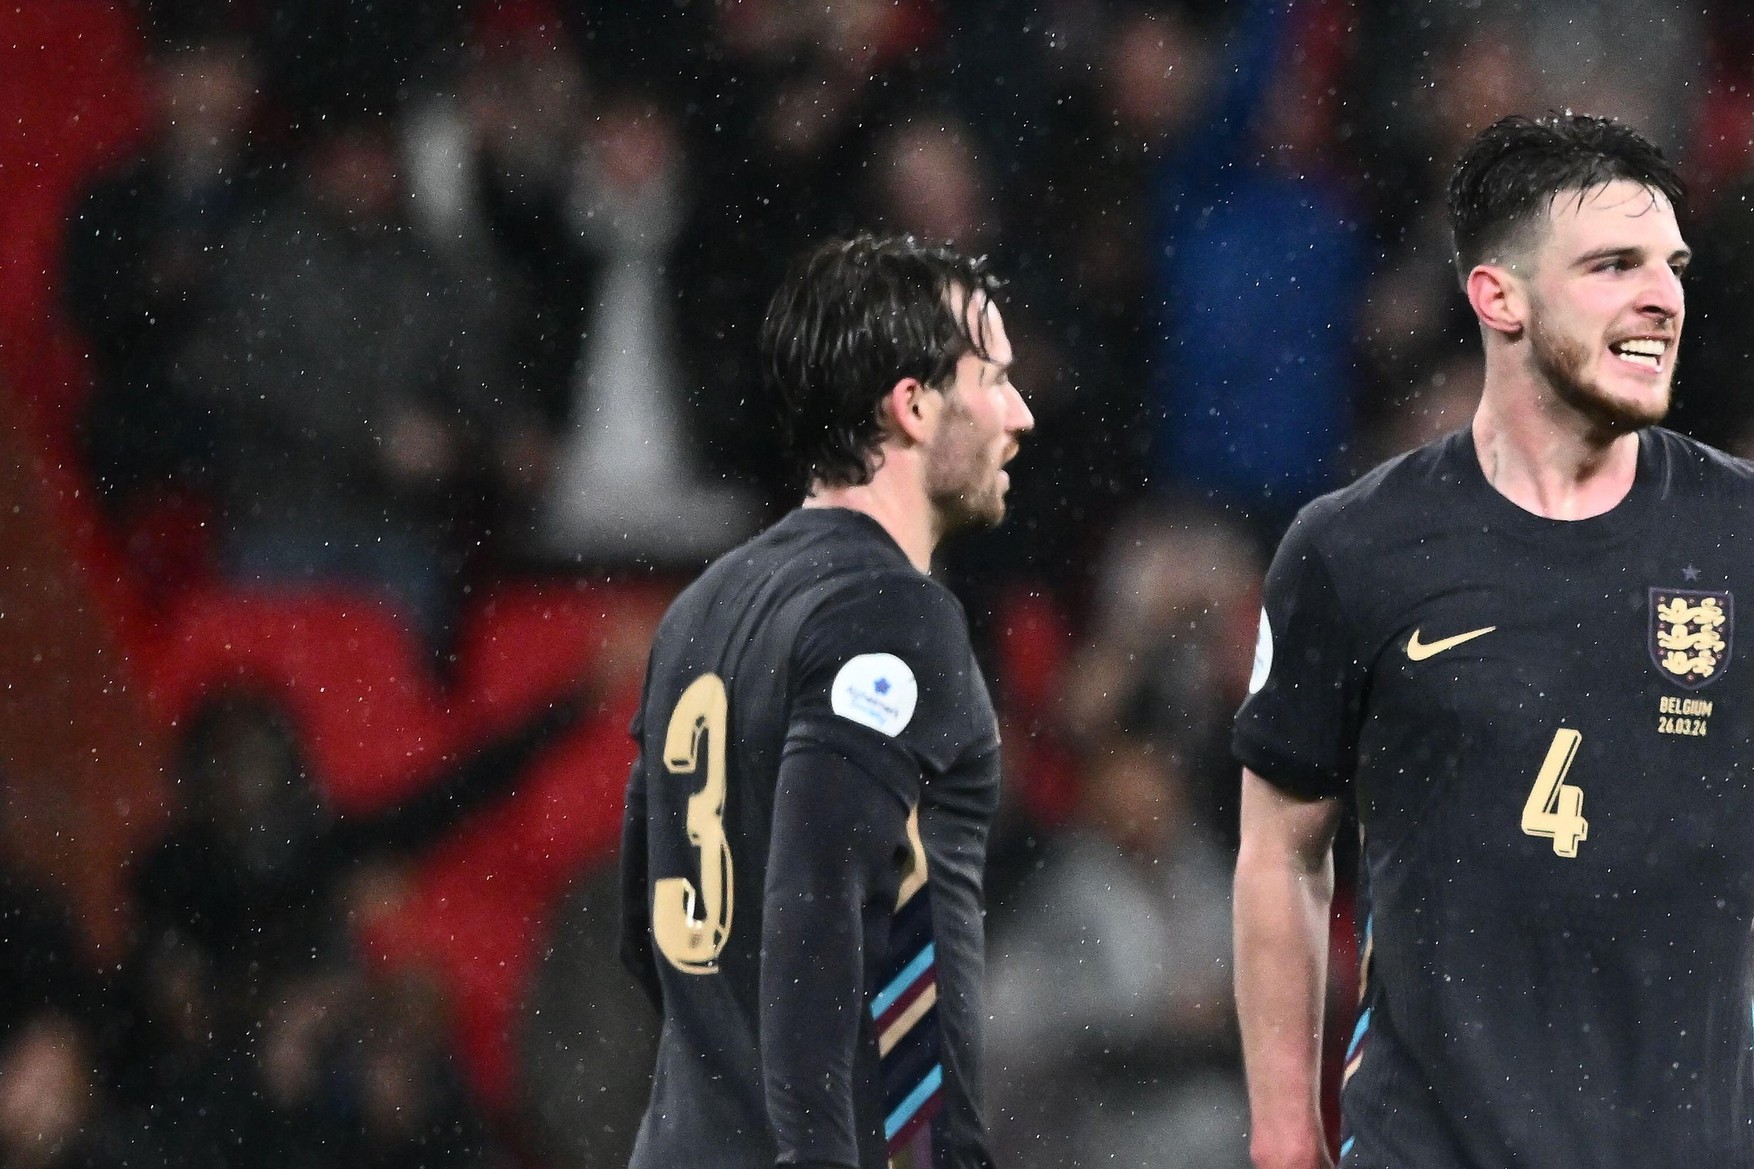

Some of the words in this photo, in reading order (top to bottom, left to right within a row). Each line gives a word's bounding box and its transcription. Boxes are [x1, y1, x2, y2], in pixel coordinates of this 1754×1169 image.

[1657, 716, 1707, 737] 26.03.24
[1660, 696, 1713, 717] BELGIUM
[653, 672, 734, 974] 3
[1521, 728, 1589, 858] 4
